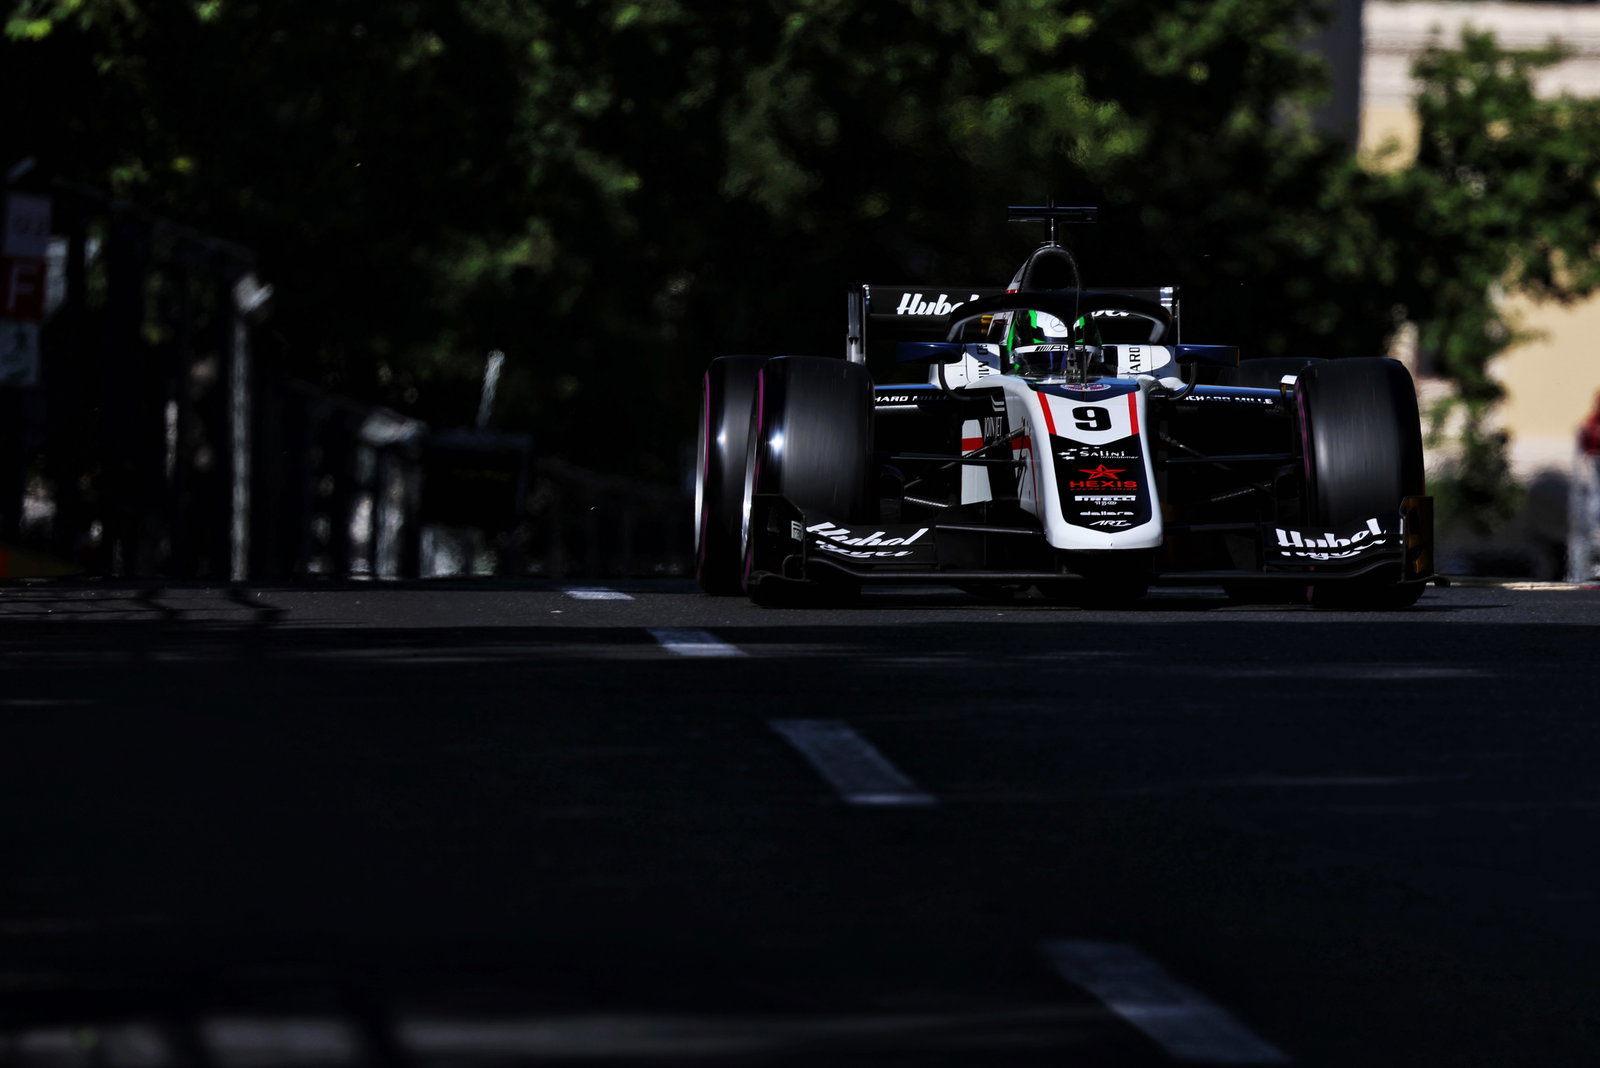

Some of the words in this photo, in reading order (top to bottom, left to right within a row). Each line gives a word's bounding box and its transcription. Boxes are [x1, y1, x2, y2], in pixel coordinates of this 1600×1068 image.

[8, 262, 38, 313] F
[896, 293, 980, 315] Hub
[1072, 406, 1112, 431] 9
